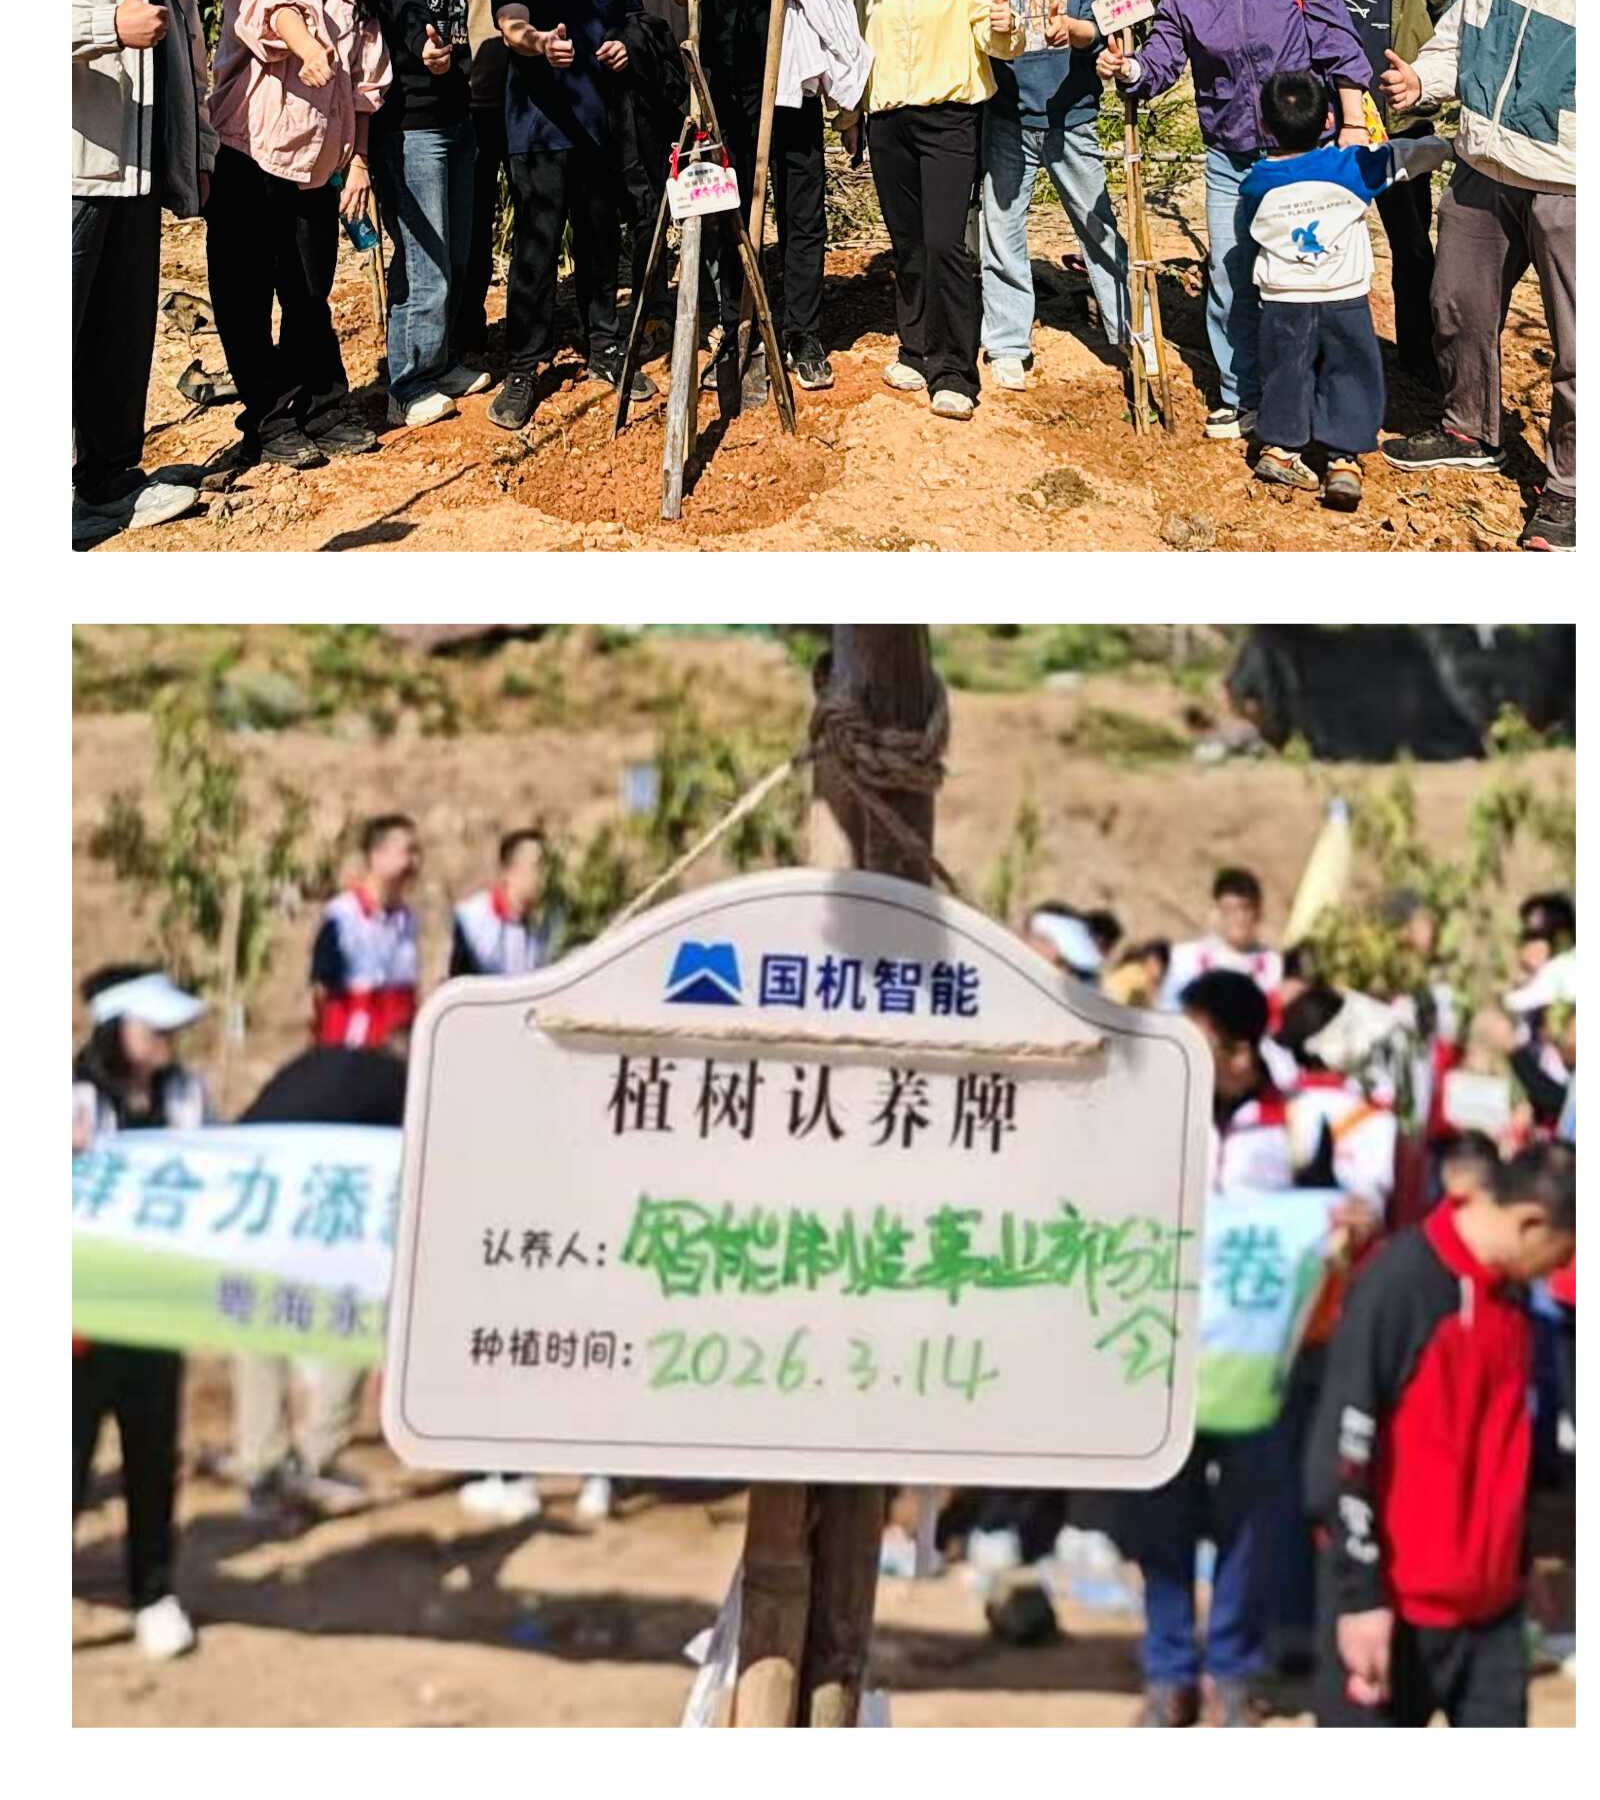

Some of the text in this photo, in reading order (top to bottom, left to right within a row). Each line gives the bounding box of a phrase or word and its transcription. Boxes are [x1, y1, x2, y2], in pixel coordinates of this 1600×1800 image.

[1288, 207, 1316, 217] PLACES
[757, 953, 981, 1019] 国机智能
[606, 1055, 1020, 1154] 植树认养牌
[646, 1329, 1001, 1402] 2026.3.14
